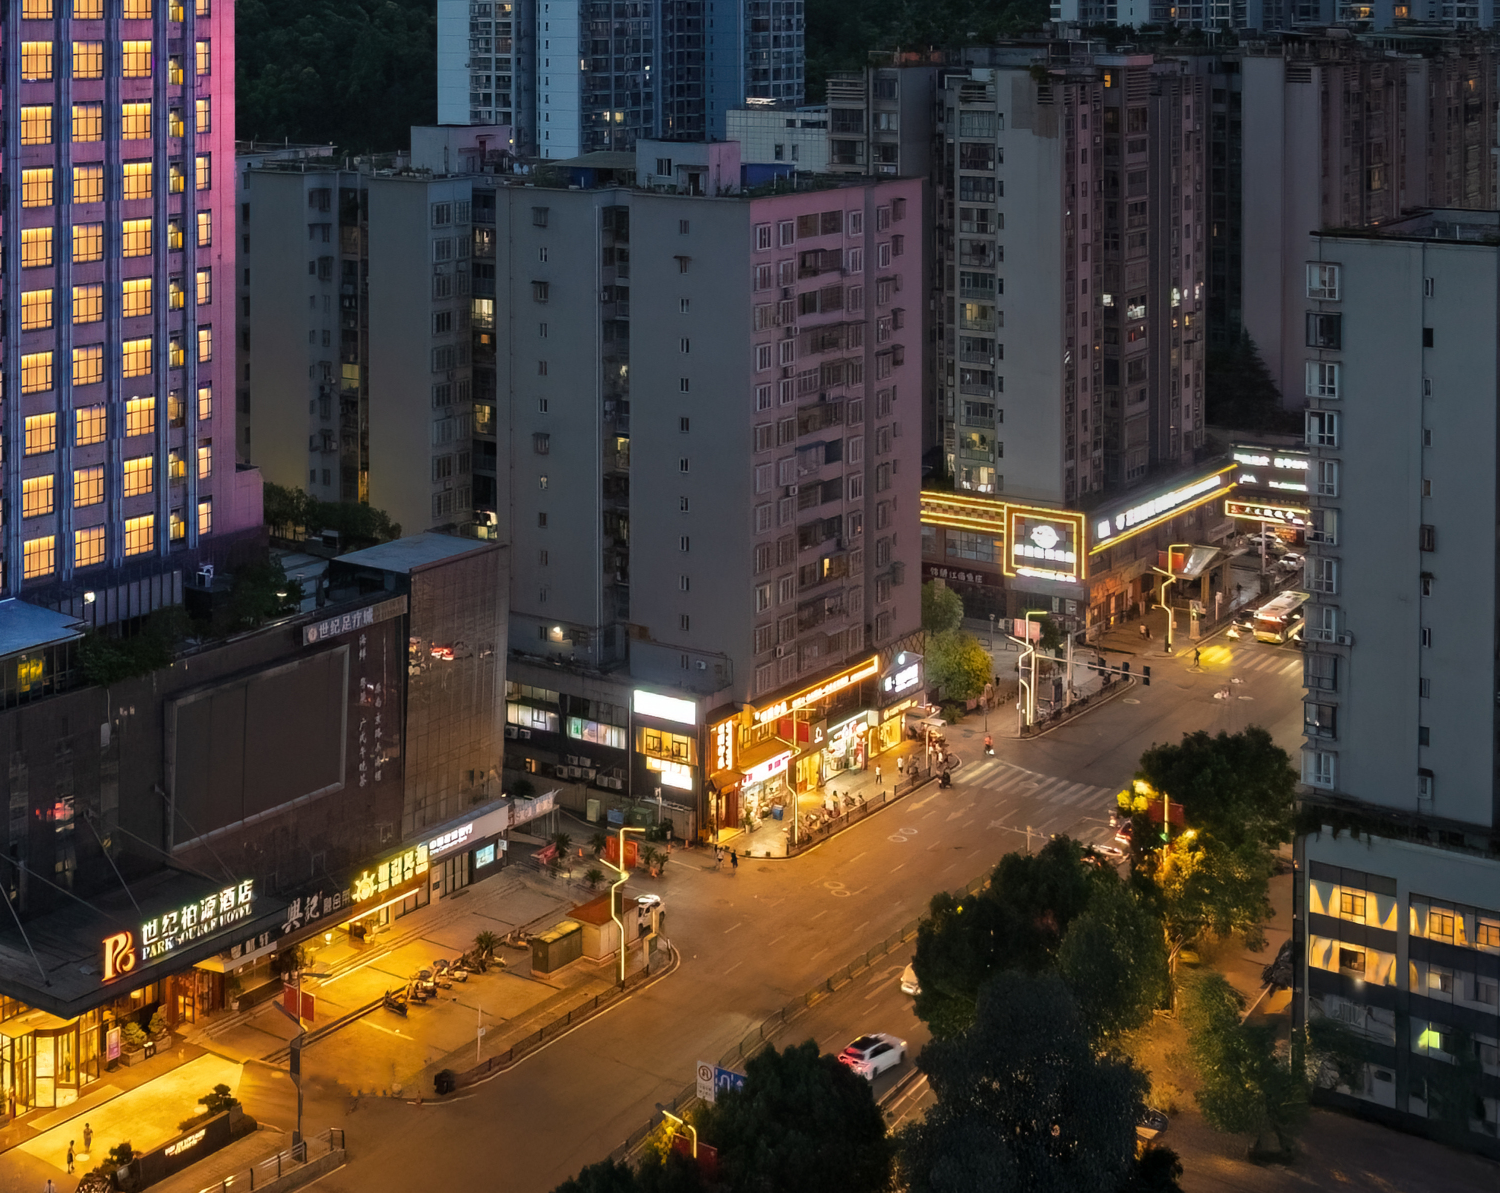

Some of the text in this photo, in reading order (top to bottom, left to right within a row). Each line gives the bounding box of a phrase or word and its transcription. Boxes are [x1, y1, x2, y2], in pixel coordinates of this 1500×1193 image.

[319, 608, 374, 639] 世纪足疗城
[142, 879, 254, 946] 世纪柏源酒店
[142, 939, 175, 961] PARK
[175, 917, 219, 946] SOURCE
[219, 904, 253, 928] HOTEL
